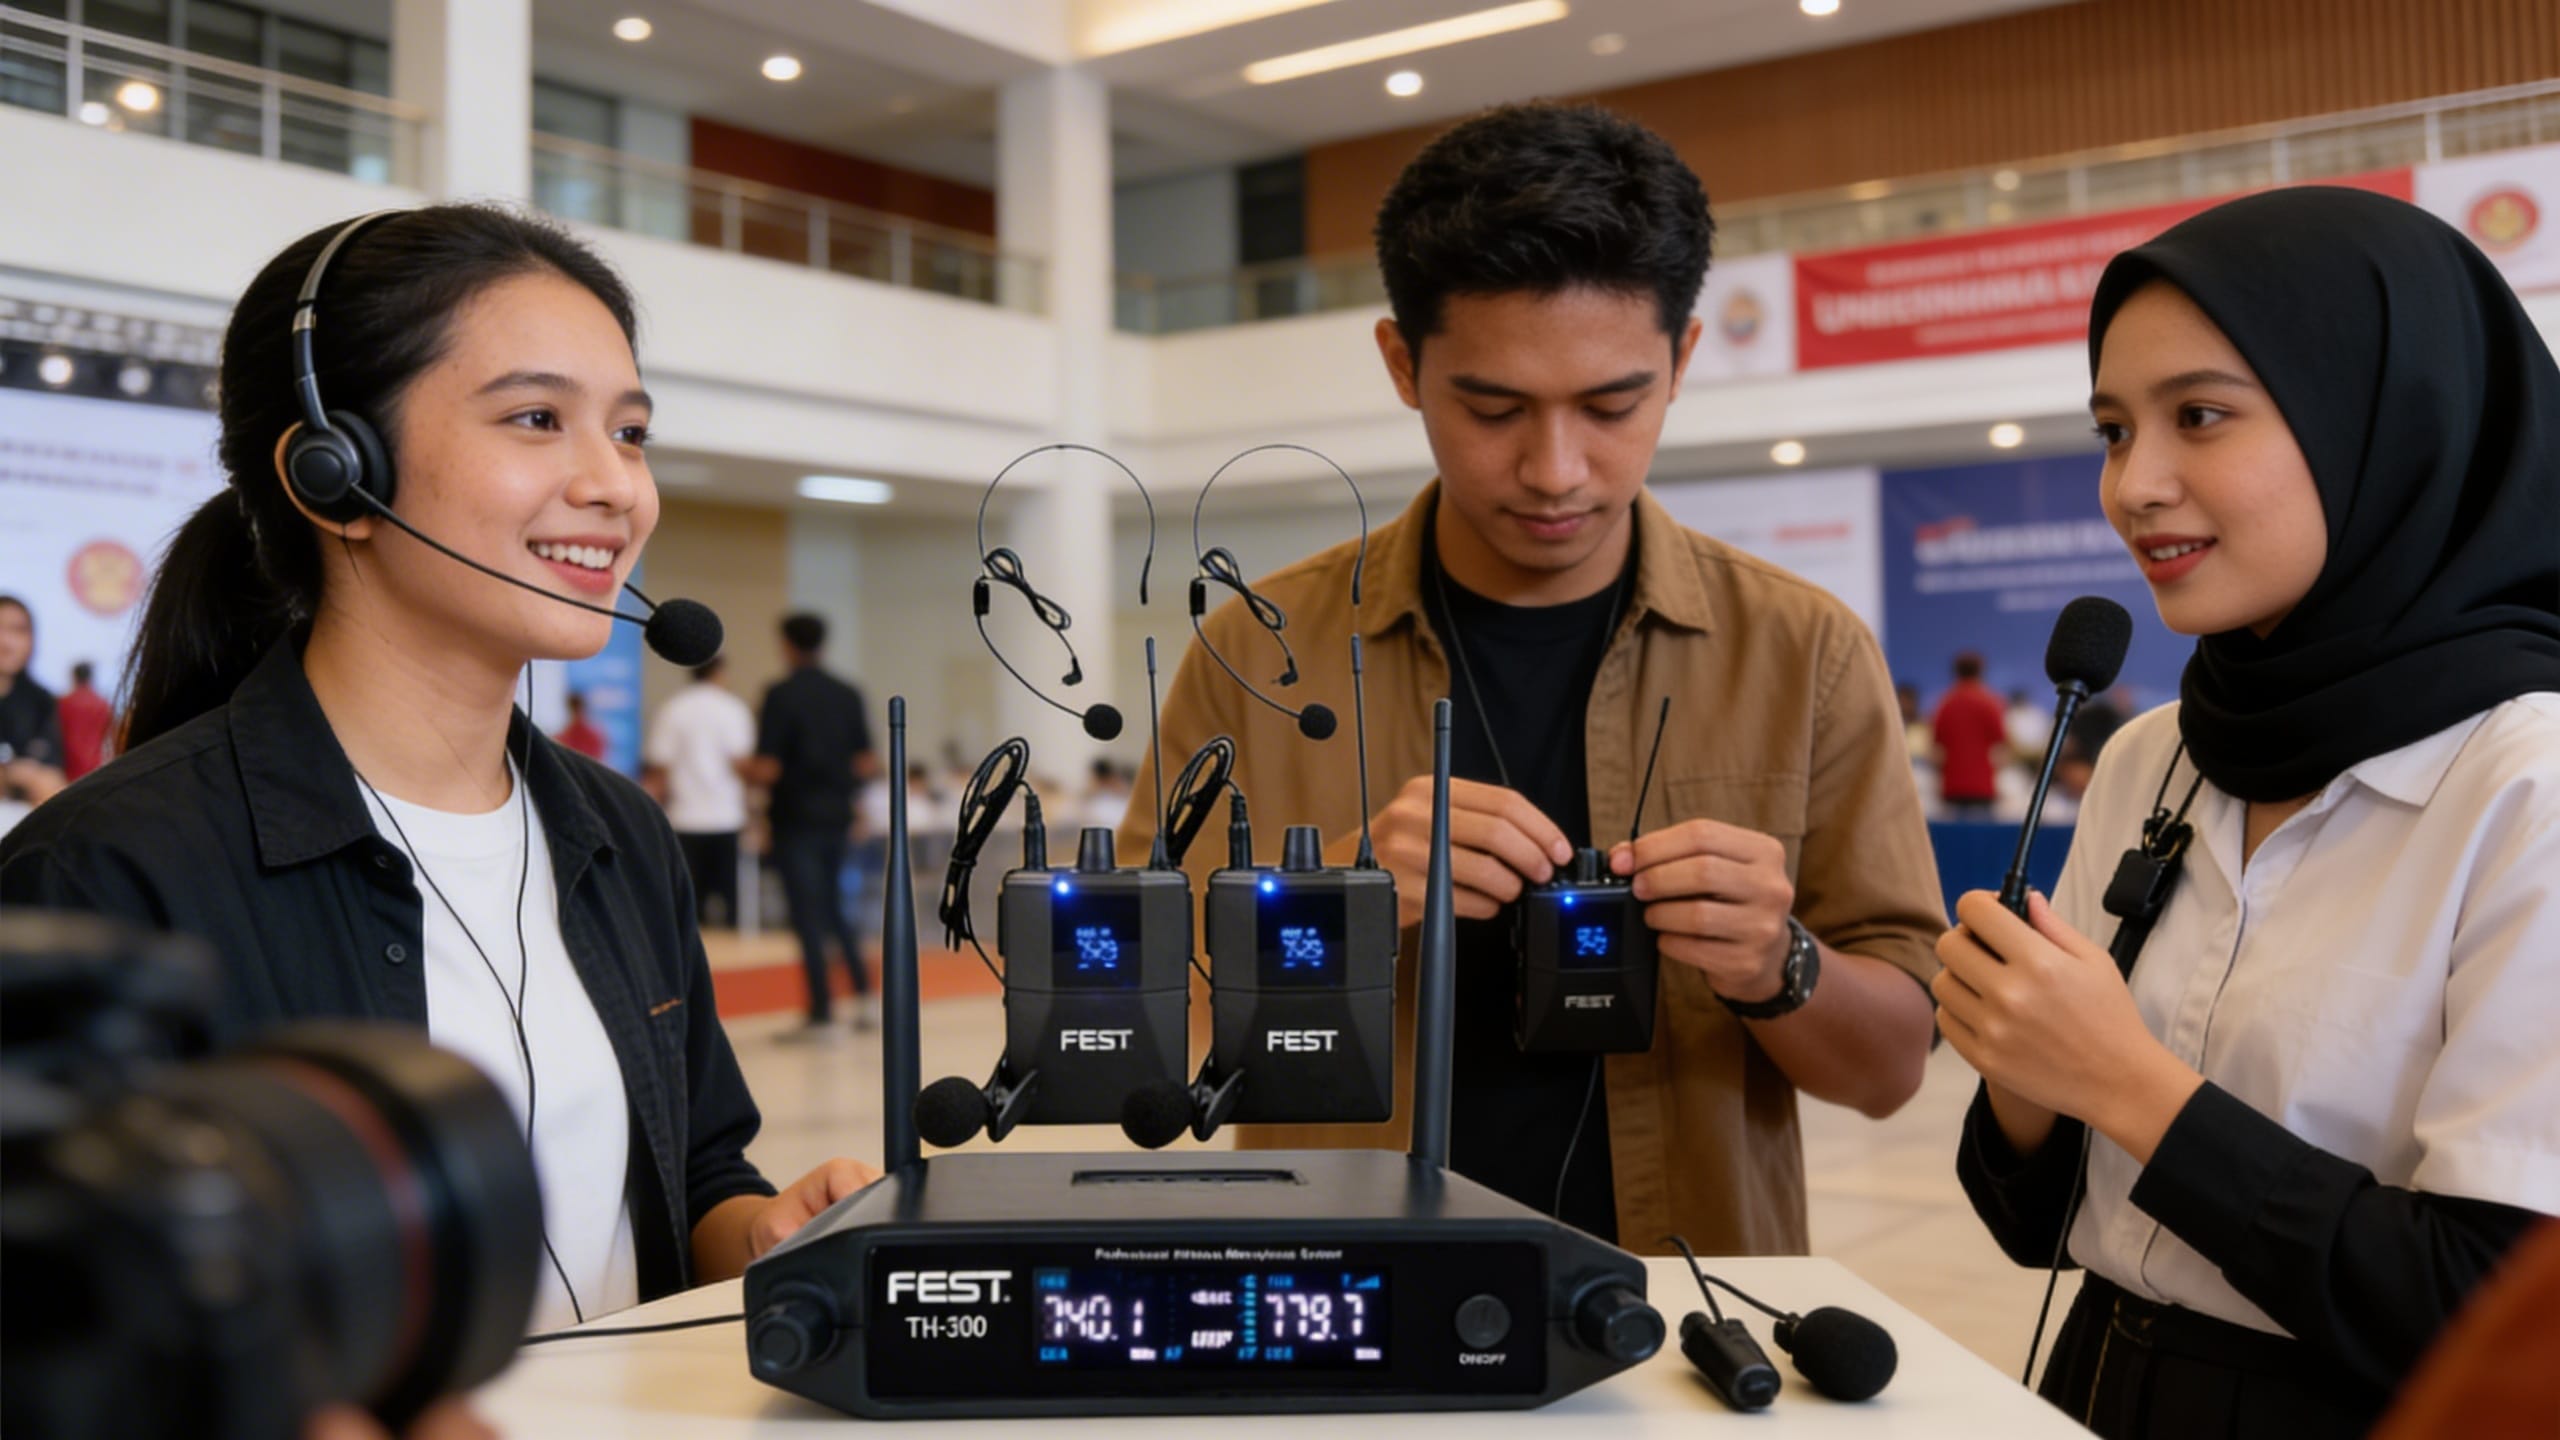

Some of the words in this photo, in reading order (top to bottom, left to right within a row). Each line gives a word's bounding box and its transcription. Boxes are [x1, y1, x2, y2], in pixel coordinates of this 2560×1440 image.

[1565, 994, 1615, 1008] FEST
[1060, 1029, 1134, 1051] FEST
[1267, 1030, 1339, 1051] FEST
[904, 1315, 988, 1339] TH-300
[1265, 1293, 1364, 1341] 779.7
